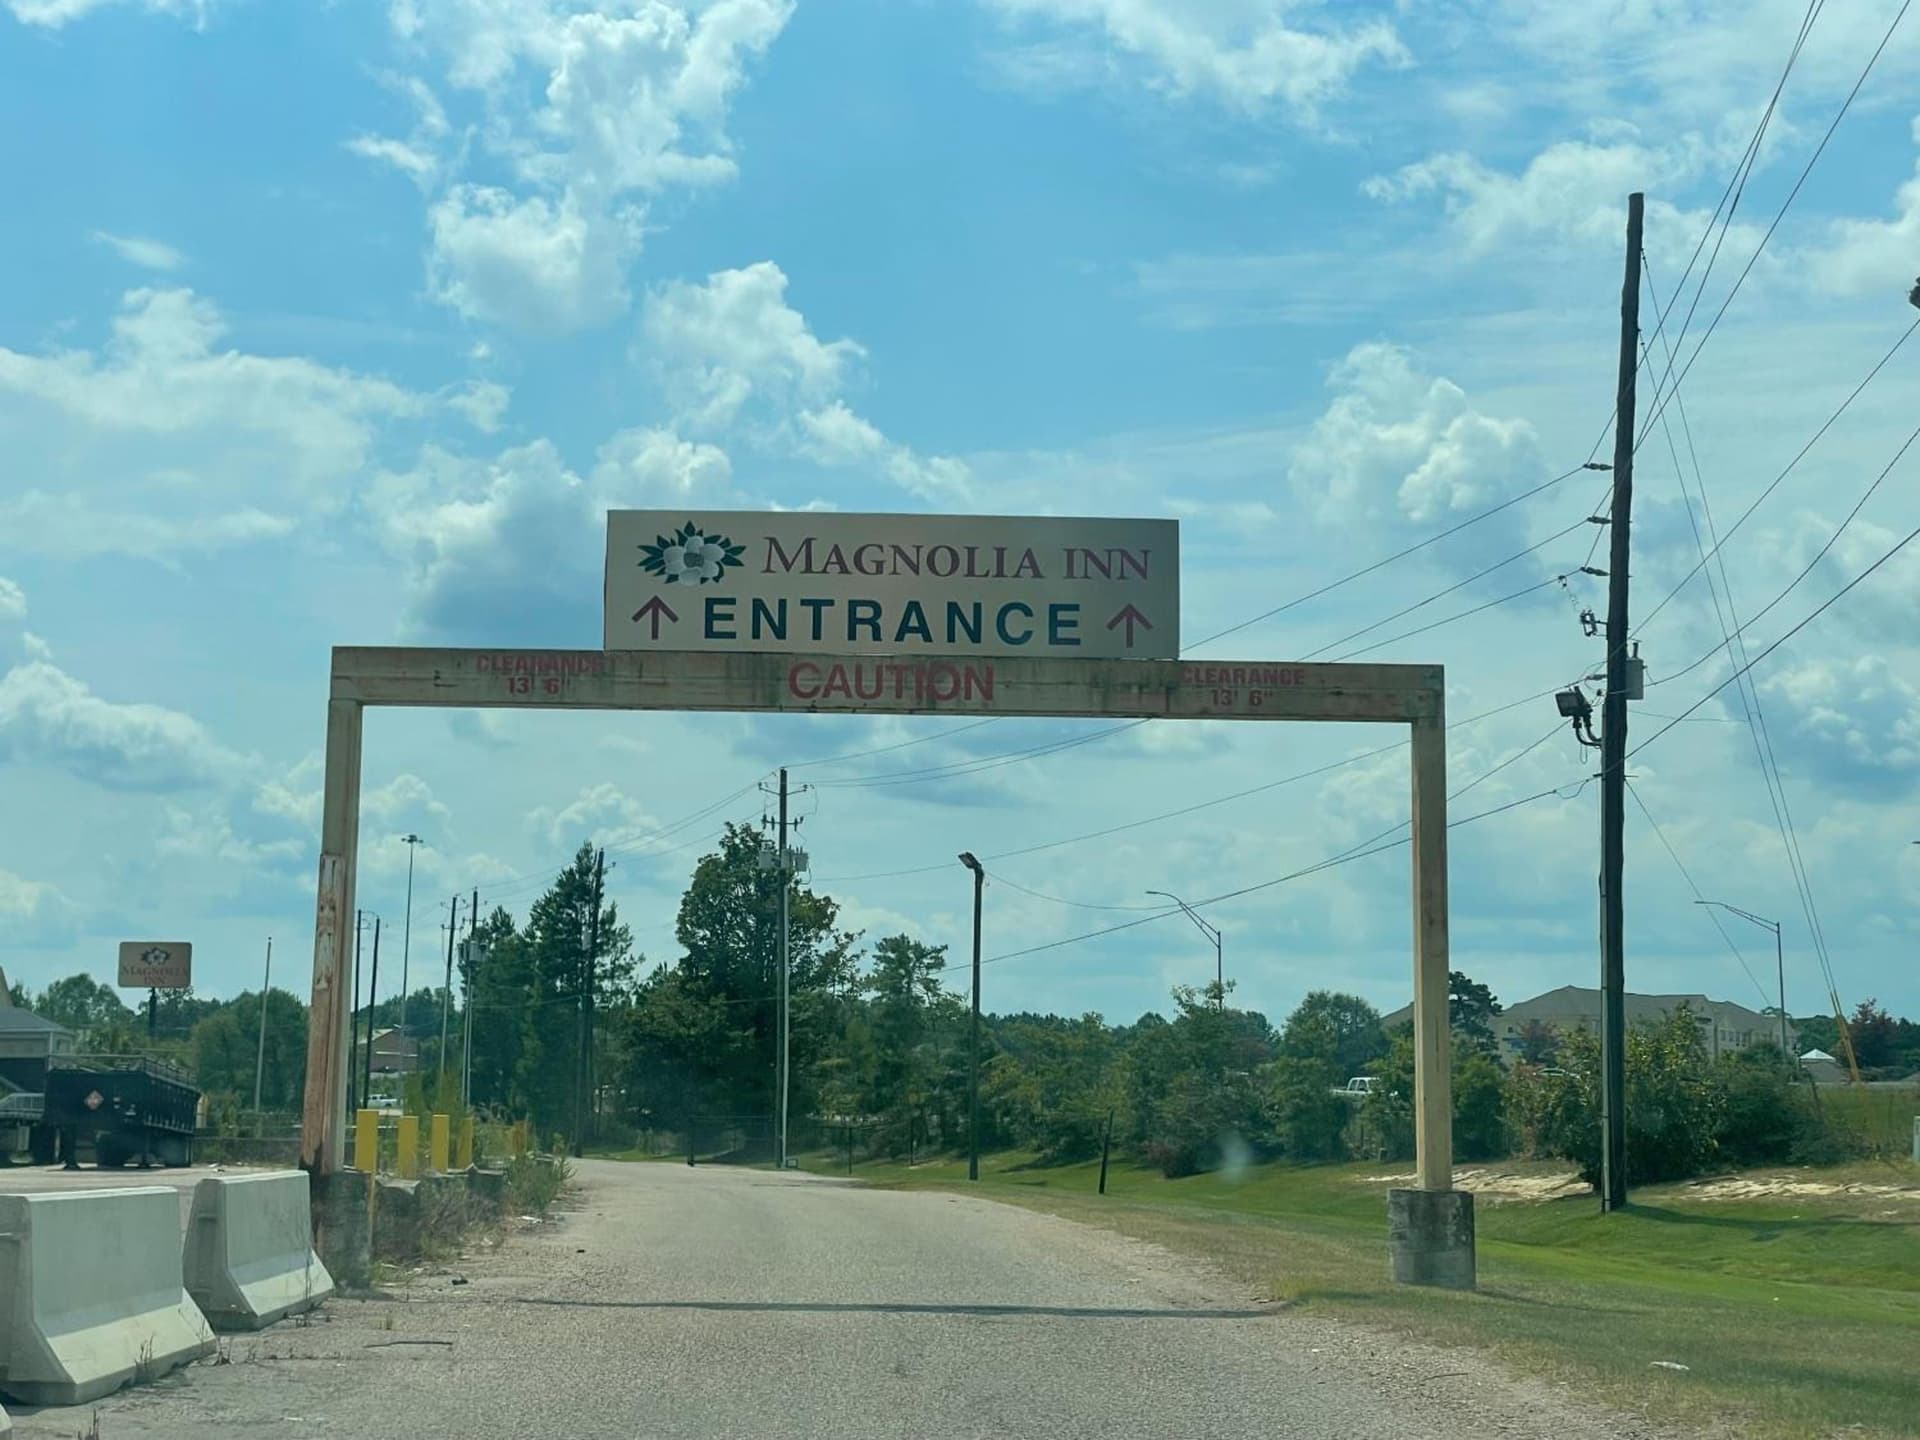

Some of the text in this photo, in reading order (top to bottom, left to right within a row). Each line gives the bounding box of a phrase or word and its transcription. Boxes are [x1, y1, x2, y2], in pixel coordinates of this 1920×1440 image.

[760, 536, 1152, 580] MAGNOLIA INN
[704, 597, 1081, 646] ENTRANCE
[476, 655, 605, 674] CLEARANCE
[788, 662, 995, 701] CAUTION
[1181, 666, 1305, 687] CLEARANCE
